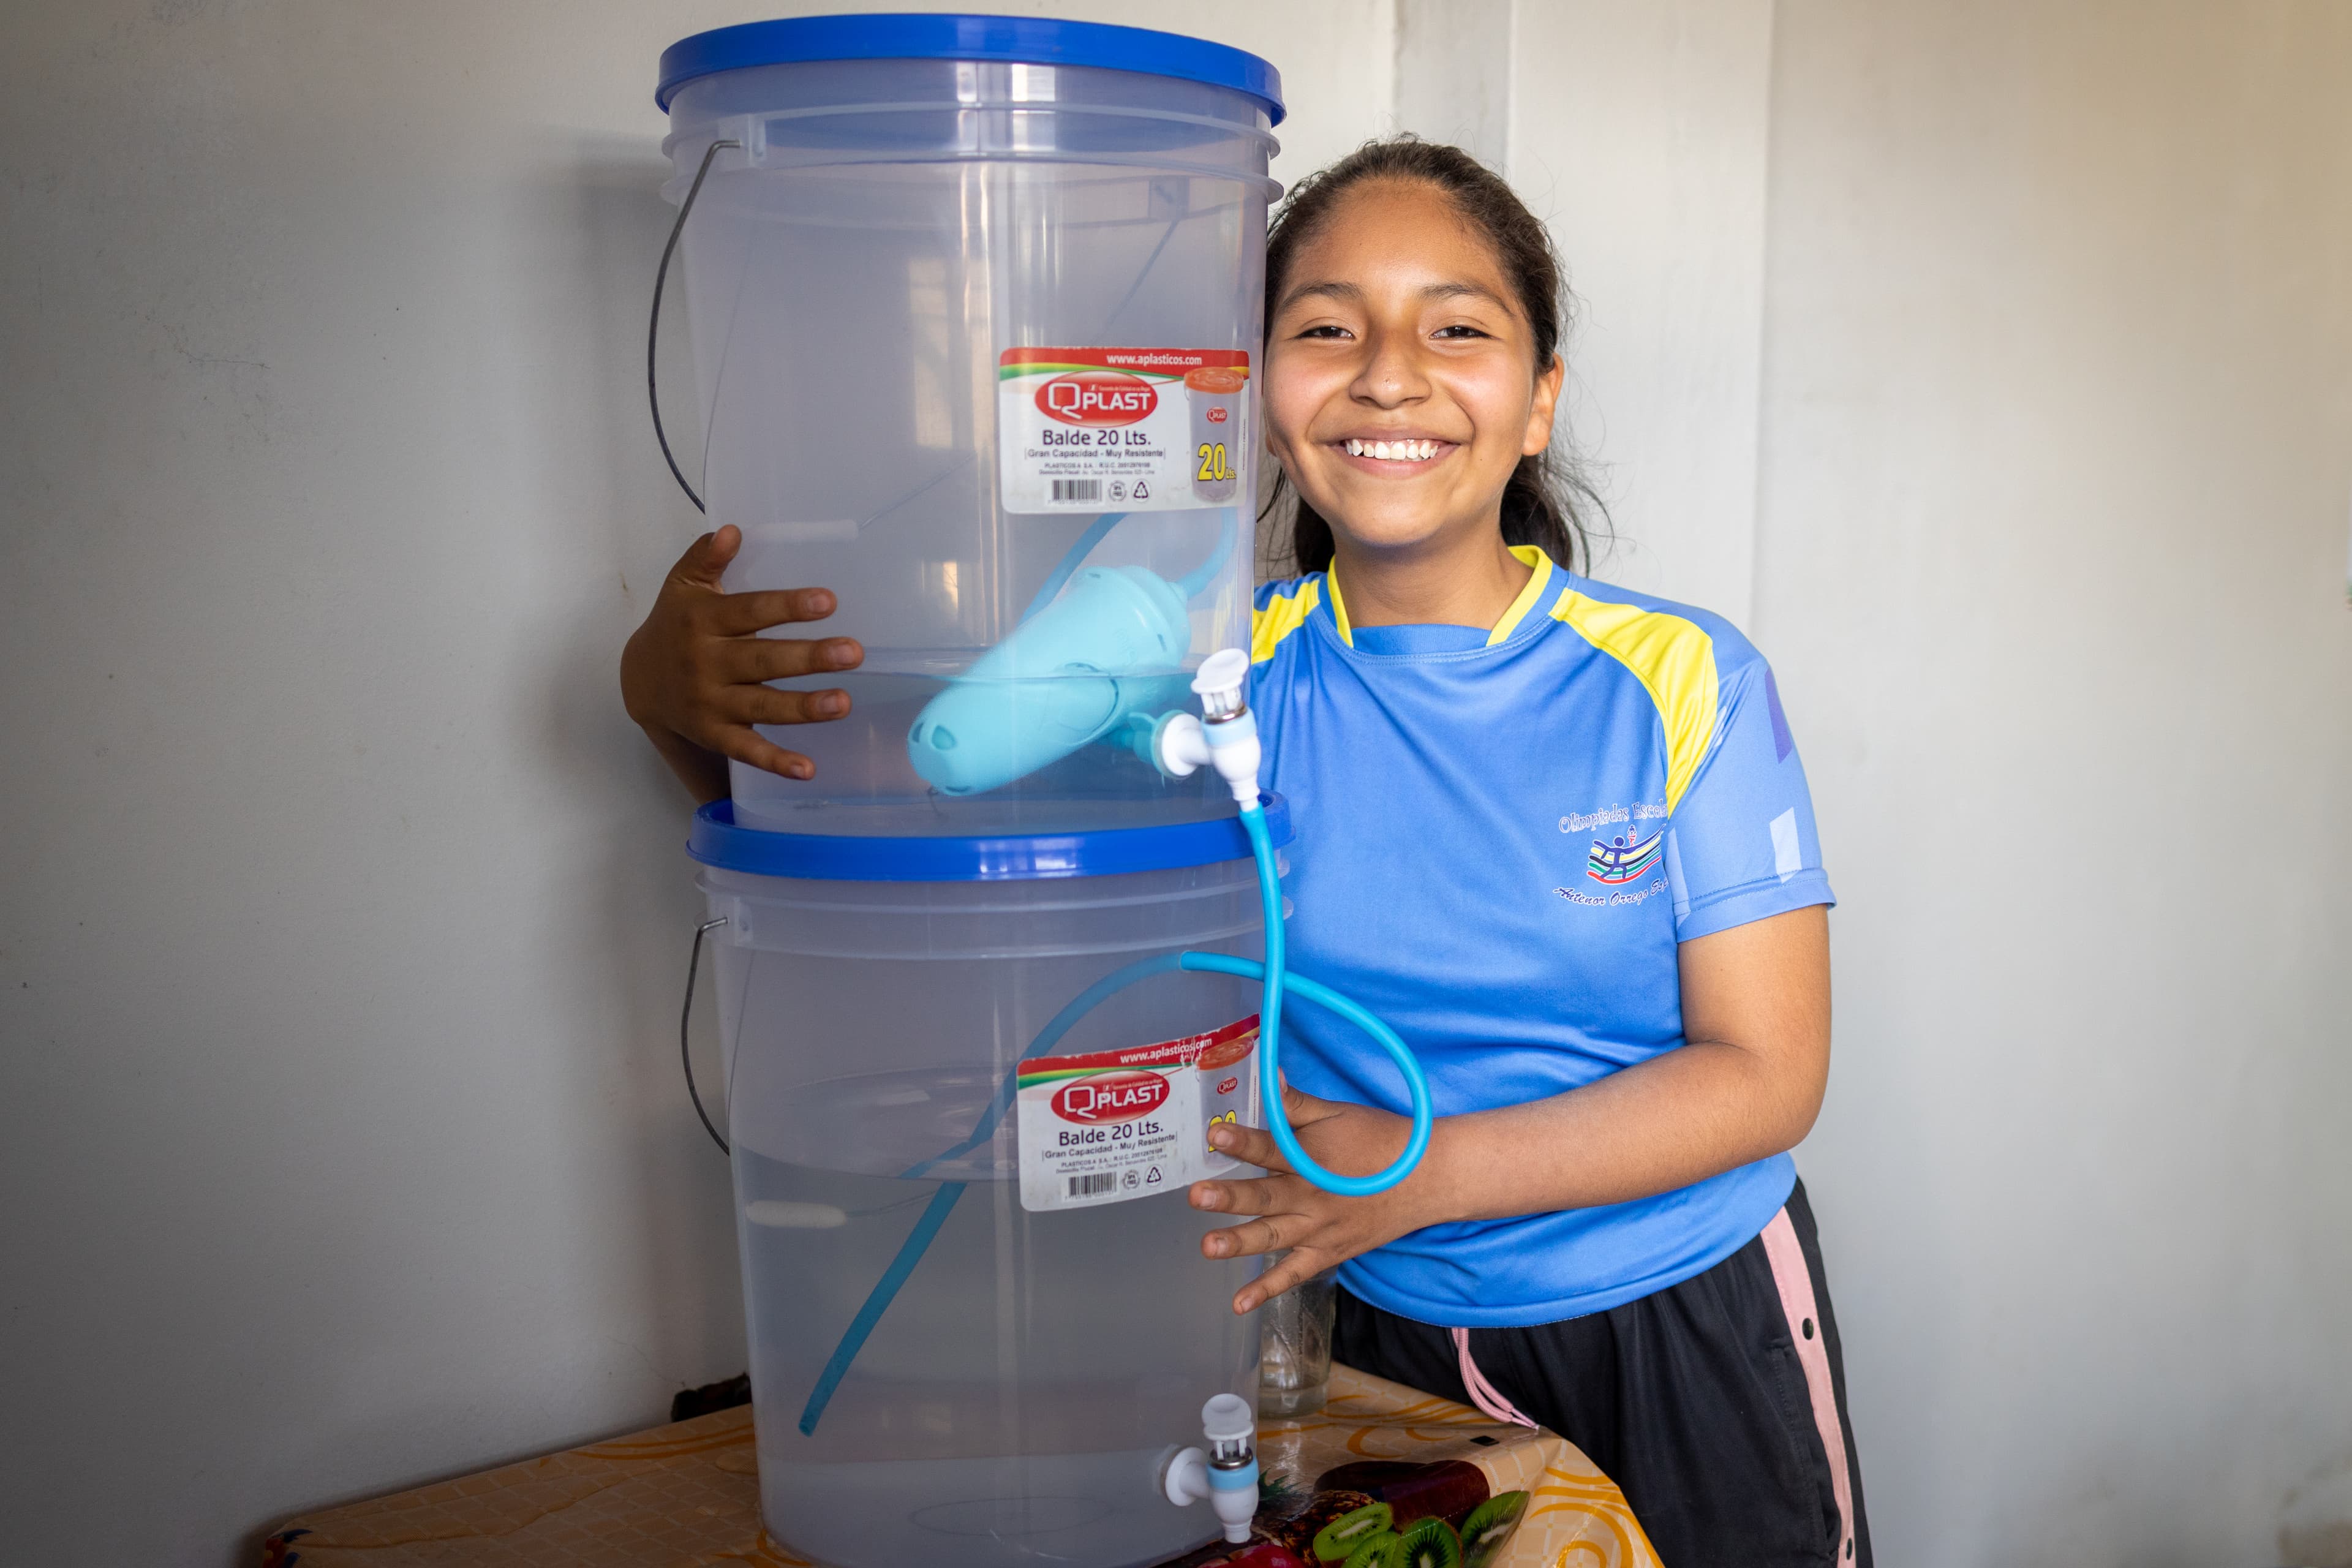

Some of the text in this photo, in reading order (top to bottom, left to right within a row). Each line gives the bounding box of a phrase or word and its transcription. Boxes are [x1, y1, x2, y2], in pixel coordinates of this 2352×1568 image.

[1107, 353, 1202, 366] www.aplasticos.com
[1048, 382, 1152, 420] QPLAST
[1043, 430, 1151, 445] Balde 20 Lts.
[1052, 449, 1098, 459] Capacidad
[1106, 449, 1121, 459] Muy
[1125, 449, 1163, 458] Resistente
[1197, 443, 1226, 481] 20
[1559, 804, 1629, 833] Olimpiadas
[1553, 888, 1606, 905] Antenor
[1610, 889, 1648, 905] Orrego
[1120, 1038, 1212, 1063] www.aplasticos.com
[1064, 1084, 1163, 1119] QPLAST
[1059, 1121, 1163, 1146] Balde 20 Lts.
[1045, 1150, 1066, 1159] Gran
[1069, 1145, 1112, 1157] Capacidad
[1138, 1134, 1175, 1147] Resistente
